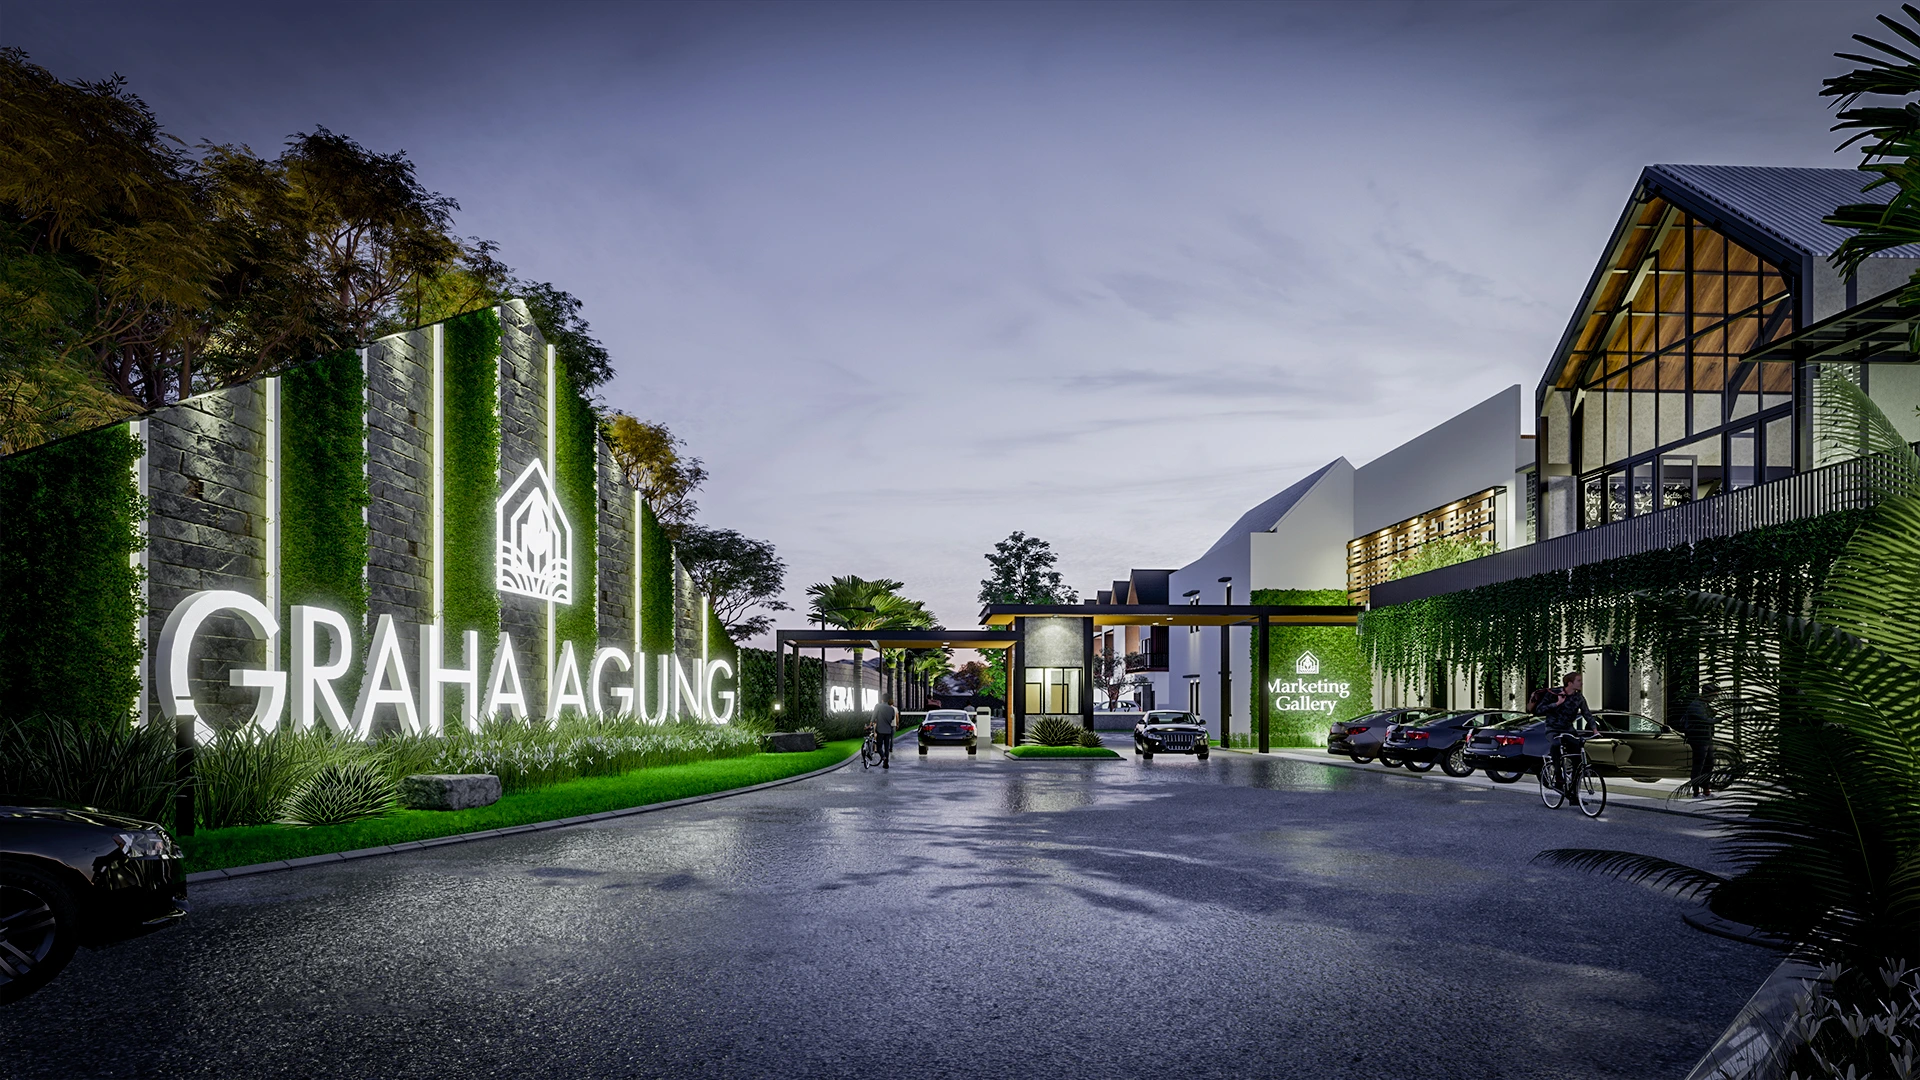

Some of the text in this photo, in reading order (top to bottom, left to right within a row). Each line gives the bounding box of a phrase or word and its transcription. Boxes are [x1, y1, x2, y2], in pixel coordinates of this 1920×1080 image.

[156, 590, 735, 749] GRAHA AGUNG
[1268, 678, 1350, 698] Marketing
[1275, 695, 1338, 716] Gallery
